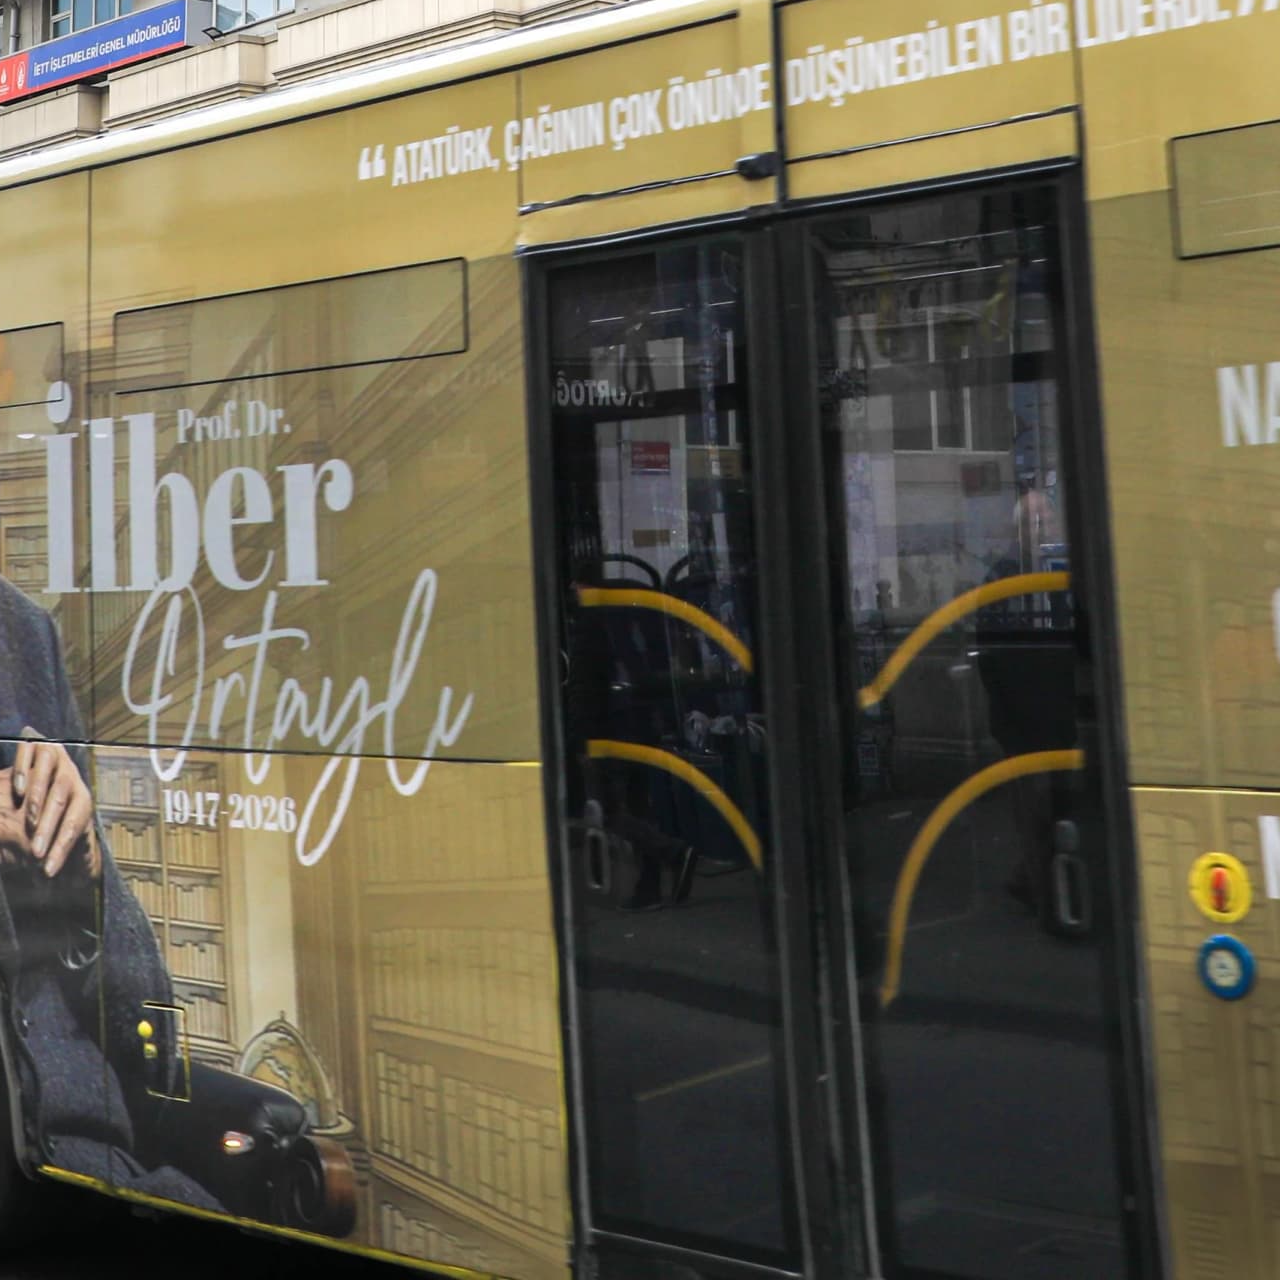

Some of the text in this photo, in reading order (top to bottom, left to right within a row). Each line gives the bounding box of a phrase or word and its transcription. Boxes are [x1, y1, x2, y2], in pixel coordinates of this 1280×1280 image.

[33, 16, 181, 77] İETT İŞLETMELERİ GENEL MÜDÜRLÜĞÜ
[504, 104, 604, 171] ÇAĞININ
[609, 89, 663, 151] ÇOK
[667, 62, 772, 131] ÖNÜNDE
[785, 20, 1003, 108] DÜŞÜNEBİLEN
[177, 399, 291, 445] Prof. Dr.
[163, 788, 297, 834] 1947-2026
